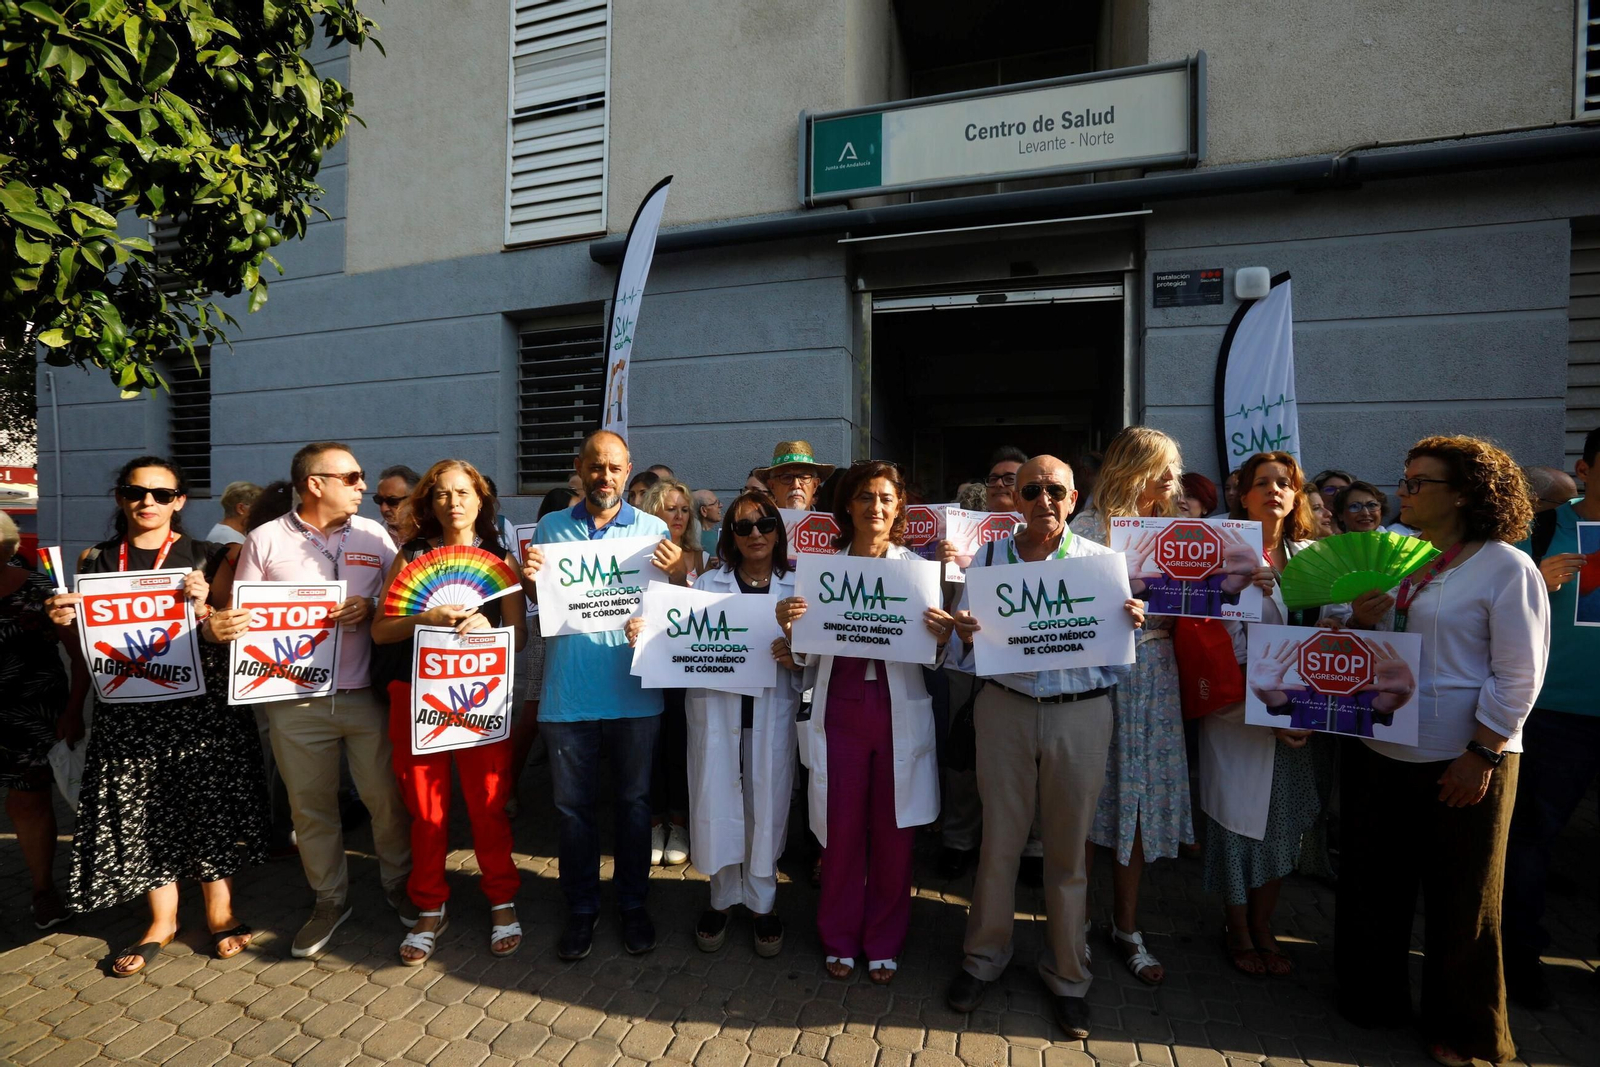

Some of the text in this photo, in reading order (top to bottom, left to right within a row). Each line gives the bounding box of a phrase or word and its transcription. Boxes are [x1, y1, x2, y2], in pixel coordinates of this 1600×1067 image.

[965, 105, 1115, 141] Centro de Salud
[1019, 136, 1066, 154] Levante
[1079, 131, 1114, 147] Norte
[846, 160, 871, 168] Andalucía
[1156, 273, 1190, 281] Instalación
[909, 512, 927, 520] SAS
[948, 509, 960, 517] UGT
[809, 520, 831, 531] SAS
[904, 521, 933, 533] STOP
[990, 520, 1011, 529] SAS
[983, 530, 1010, 542] STO
[1174, 528, 1204, 540] SAS
[801, 546, 835, 554] AGRESIONES
[1163, 541, 1215, 560] STOP
[558, 553, 640, 588] SMA
[1165, 560, 1212, 568] AGRESIONES
[586, 585, 643, 598] CORDOBA
[818, 570, 908, 610] SMA
[568, 597, 641, 611] SINDICATO MÉDICO
[996, 576, 1095, 619] SMA
[91, 595, 175, 622] STOP
[581, 608, 631, 619] DE CÓRDOBA
[248, 606, 328, 628] STOP
[666, 606, 749, 642] SMA
[843, 611, 907, 625] CORDOBA
[1028, 616, 1098, 631] CORDOBA
[823, 622, 903, 635] SINDICATO MÉDICO
[836, 634, 891, 645] DE CÓRDOBA
[1008, 630, 1096, 645] SINDICATO MÉDICO
[123, 627, 171, 664] NO
[273, 634, 316, 665] NO
[691, 643, 749, 653] CORDOBA
[1023, 643, 1084, 655] DE CÓRDOBA
[1320, 638, 1352, 652] SAS
[424, 653, 498, 676] STOP
[672, 654, 746, 664] SINDICATO MÉDICO
[1307, 652, 1365, 674] STOP
[93, 657, 192, 682] AGRESIONES
[235, 660, 330, 683] AGRESIONES
[684, 664, 735, 673] DE CÓRDOBA
[1309, 673, 1360, 683] AGRESIONES
[448, 681, 489, 715] NO
[415, 708, 504, 730] AGRESIONES
